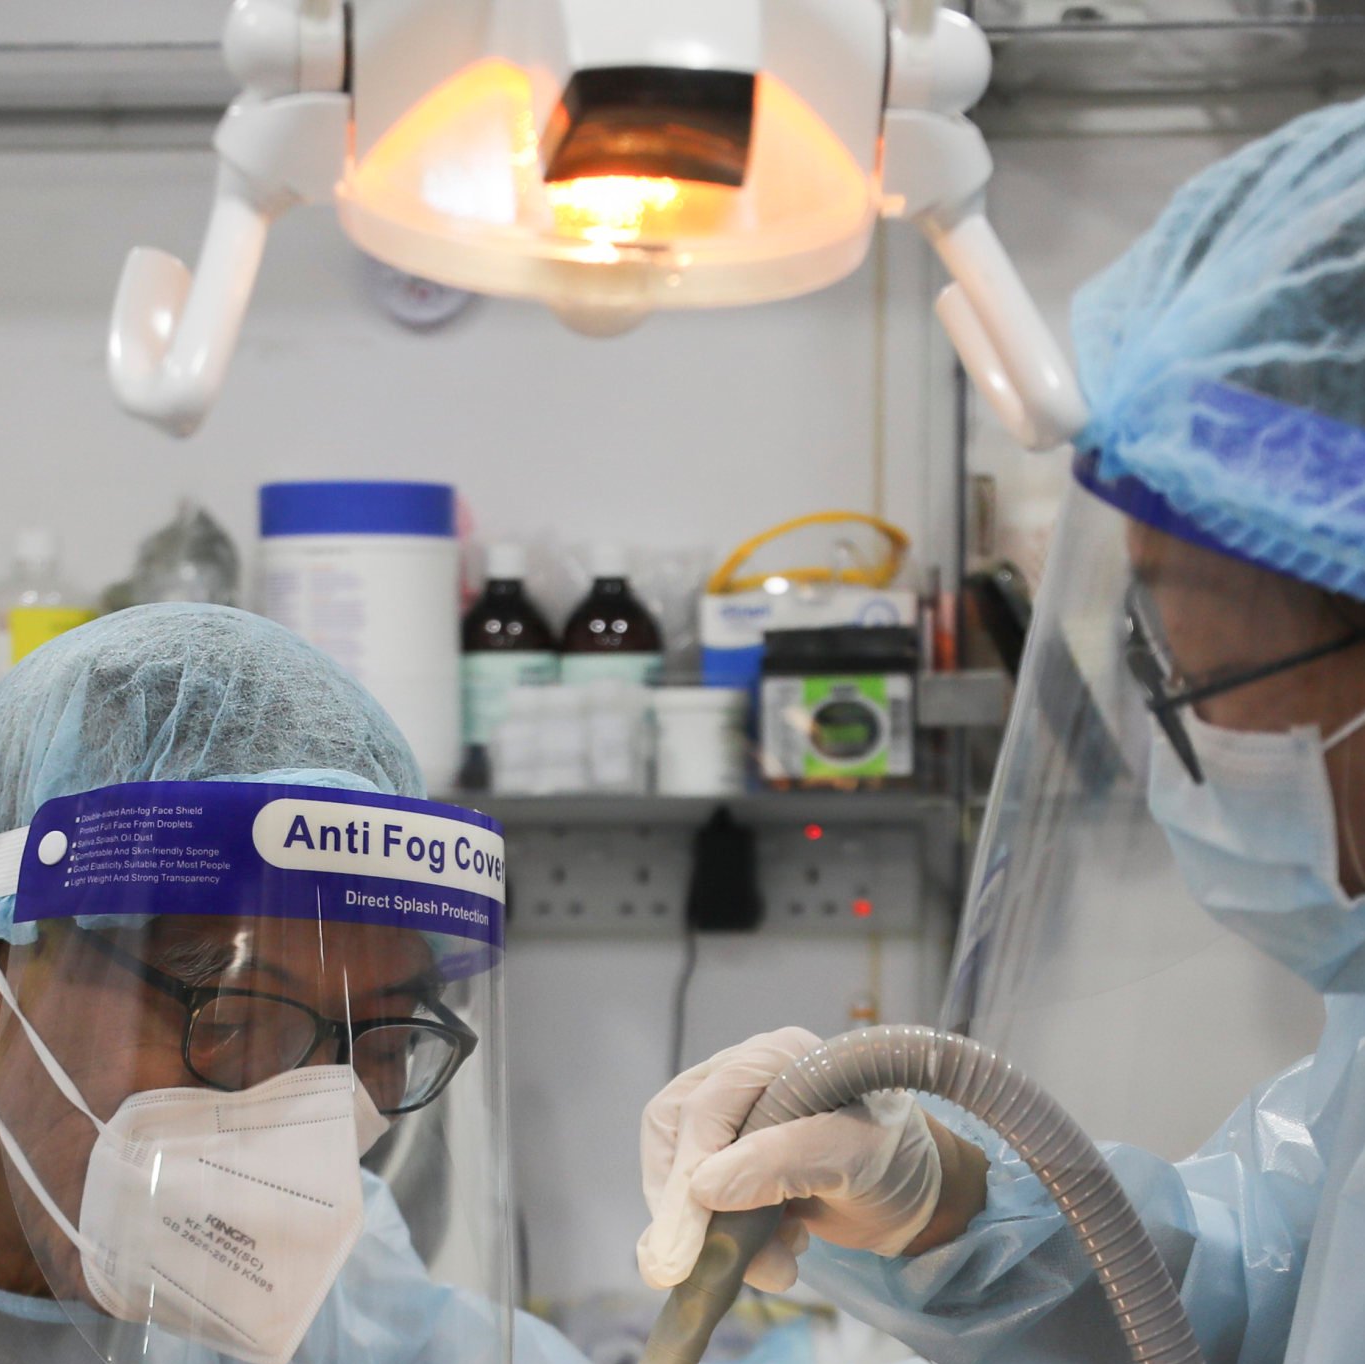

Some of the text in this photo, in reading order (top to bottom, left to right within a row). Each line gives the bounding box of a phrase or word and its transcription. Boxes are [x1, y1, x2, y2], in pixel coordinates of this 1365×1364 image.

[81, 806, 203, 823] Double-sided Anti-fog Face Shield
[113, 821, 131, 829] Face
[133, 820, 155, 828] From
[283, 815, 370, 855] Anti
[383, 823, 445, 874] Fog
[75, 847, 220, 861] Comfortable And Skin-friendly Sponge
[73, 864, 89, 873] Good
[176, 861, 198, 869] Most
[200, 861, 231, 870] People
[70, 873, 220, 887] Light Weight And Strong Transparency
[345, 890, 489, 926] Direct Splash Protection
[162, 1216, 181, 1232] GB
[241, 1268, 274, 1293] KN95
